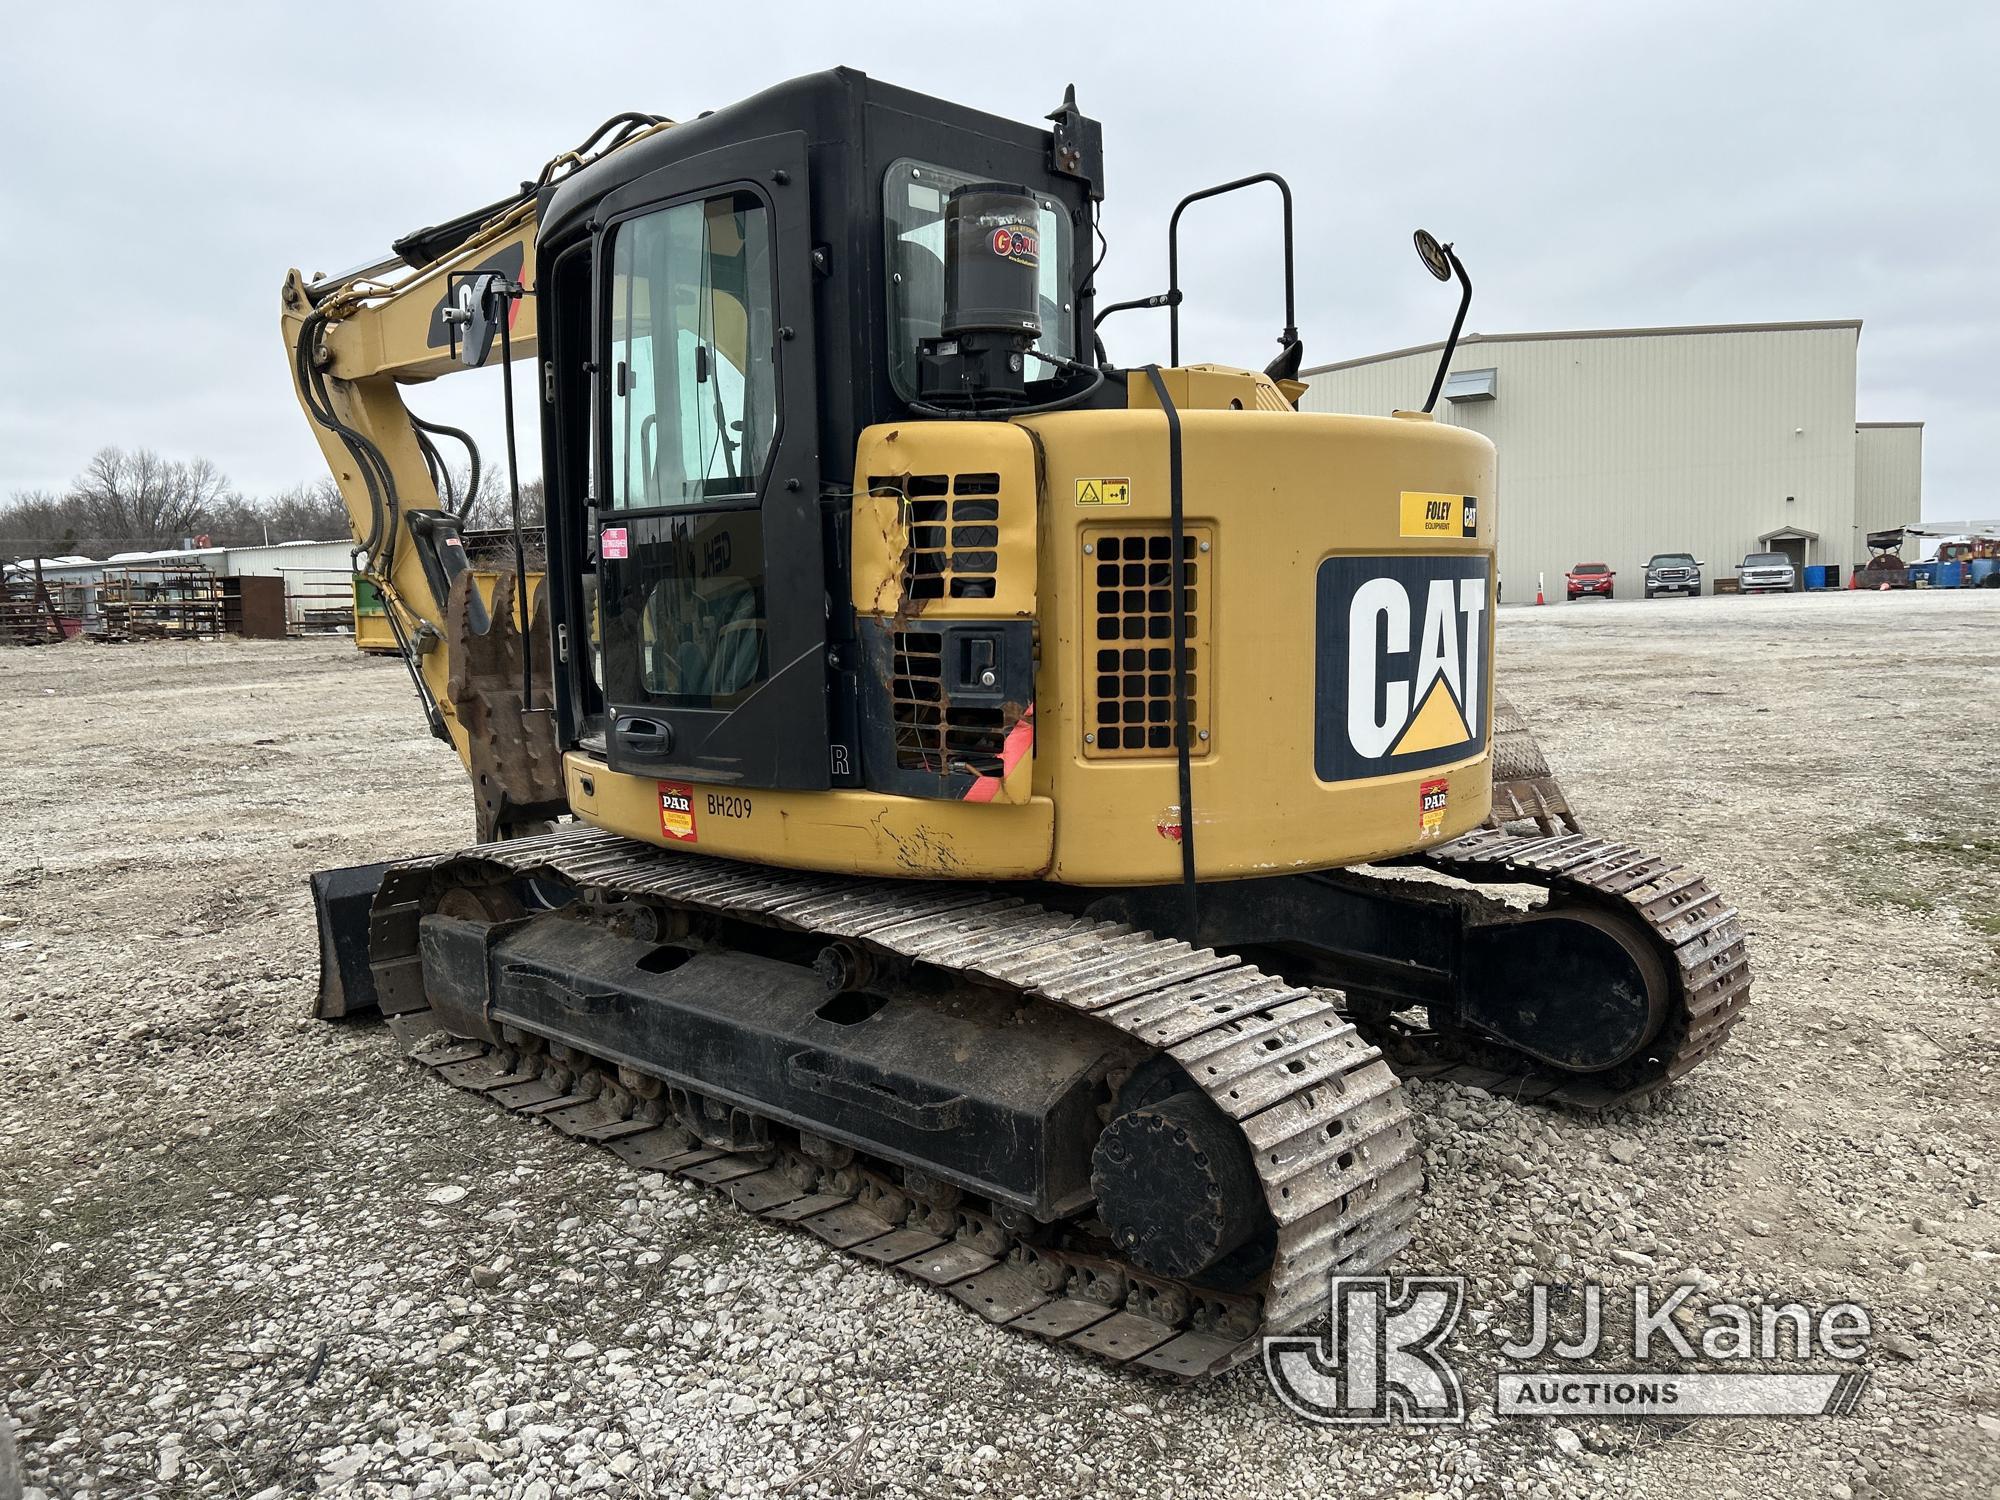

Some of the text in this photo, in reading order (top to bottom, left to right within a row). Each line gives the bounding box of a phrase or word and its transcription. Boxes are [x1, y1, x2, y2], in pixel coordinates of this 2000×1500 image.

[1425, 501, 1451, 520] FOLEY
[1464, 507, 1476, 527] CAT
[1425, 522, 1450, 530] EQUIPMENT
[1347, 577, 1485, 759] CAT
[830, 744, 850, 775] R
[662, 795, 690, 811] PAR
[707, 794, 752, 818] BH209
[1424, 793, 1446, 810] PAR
